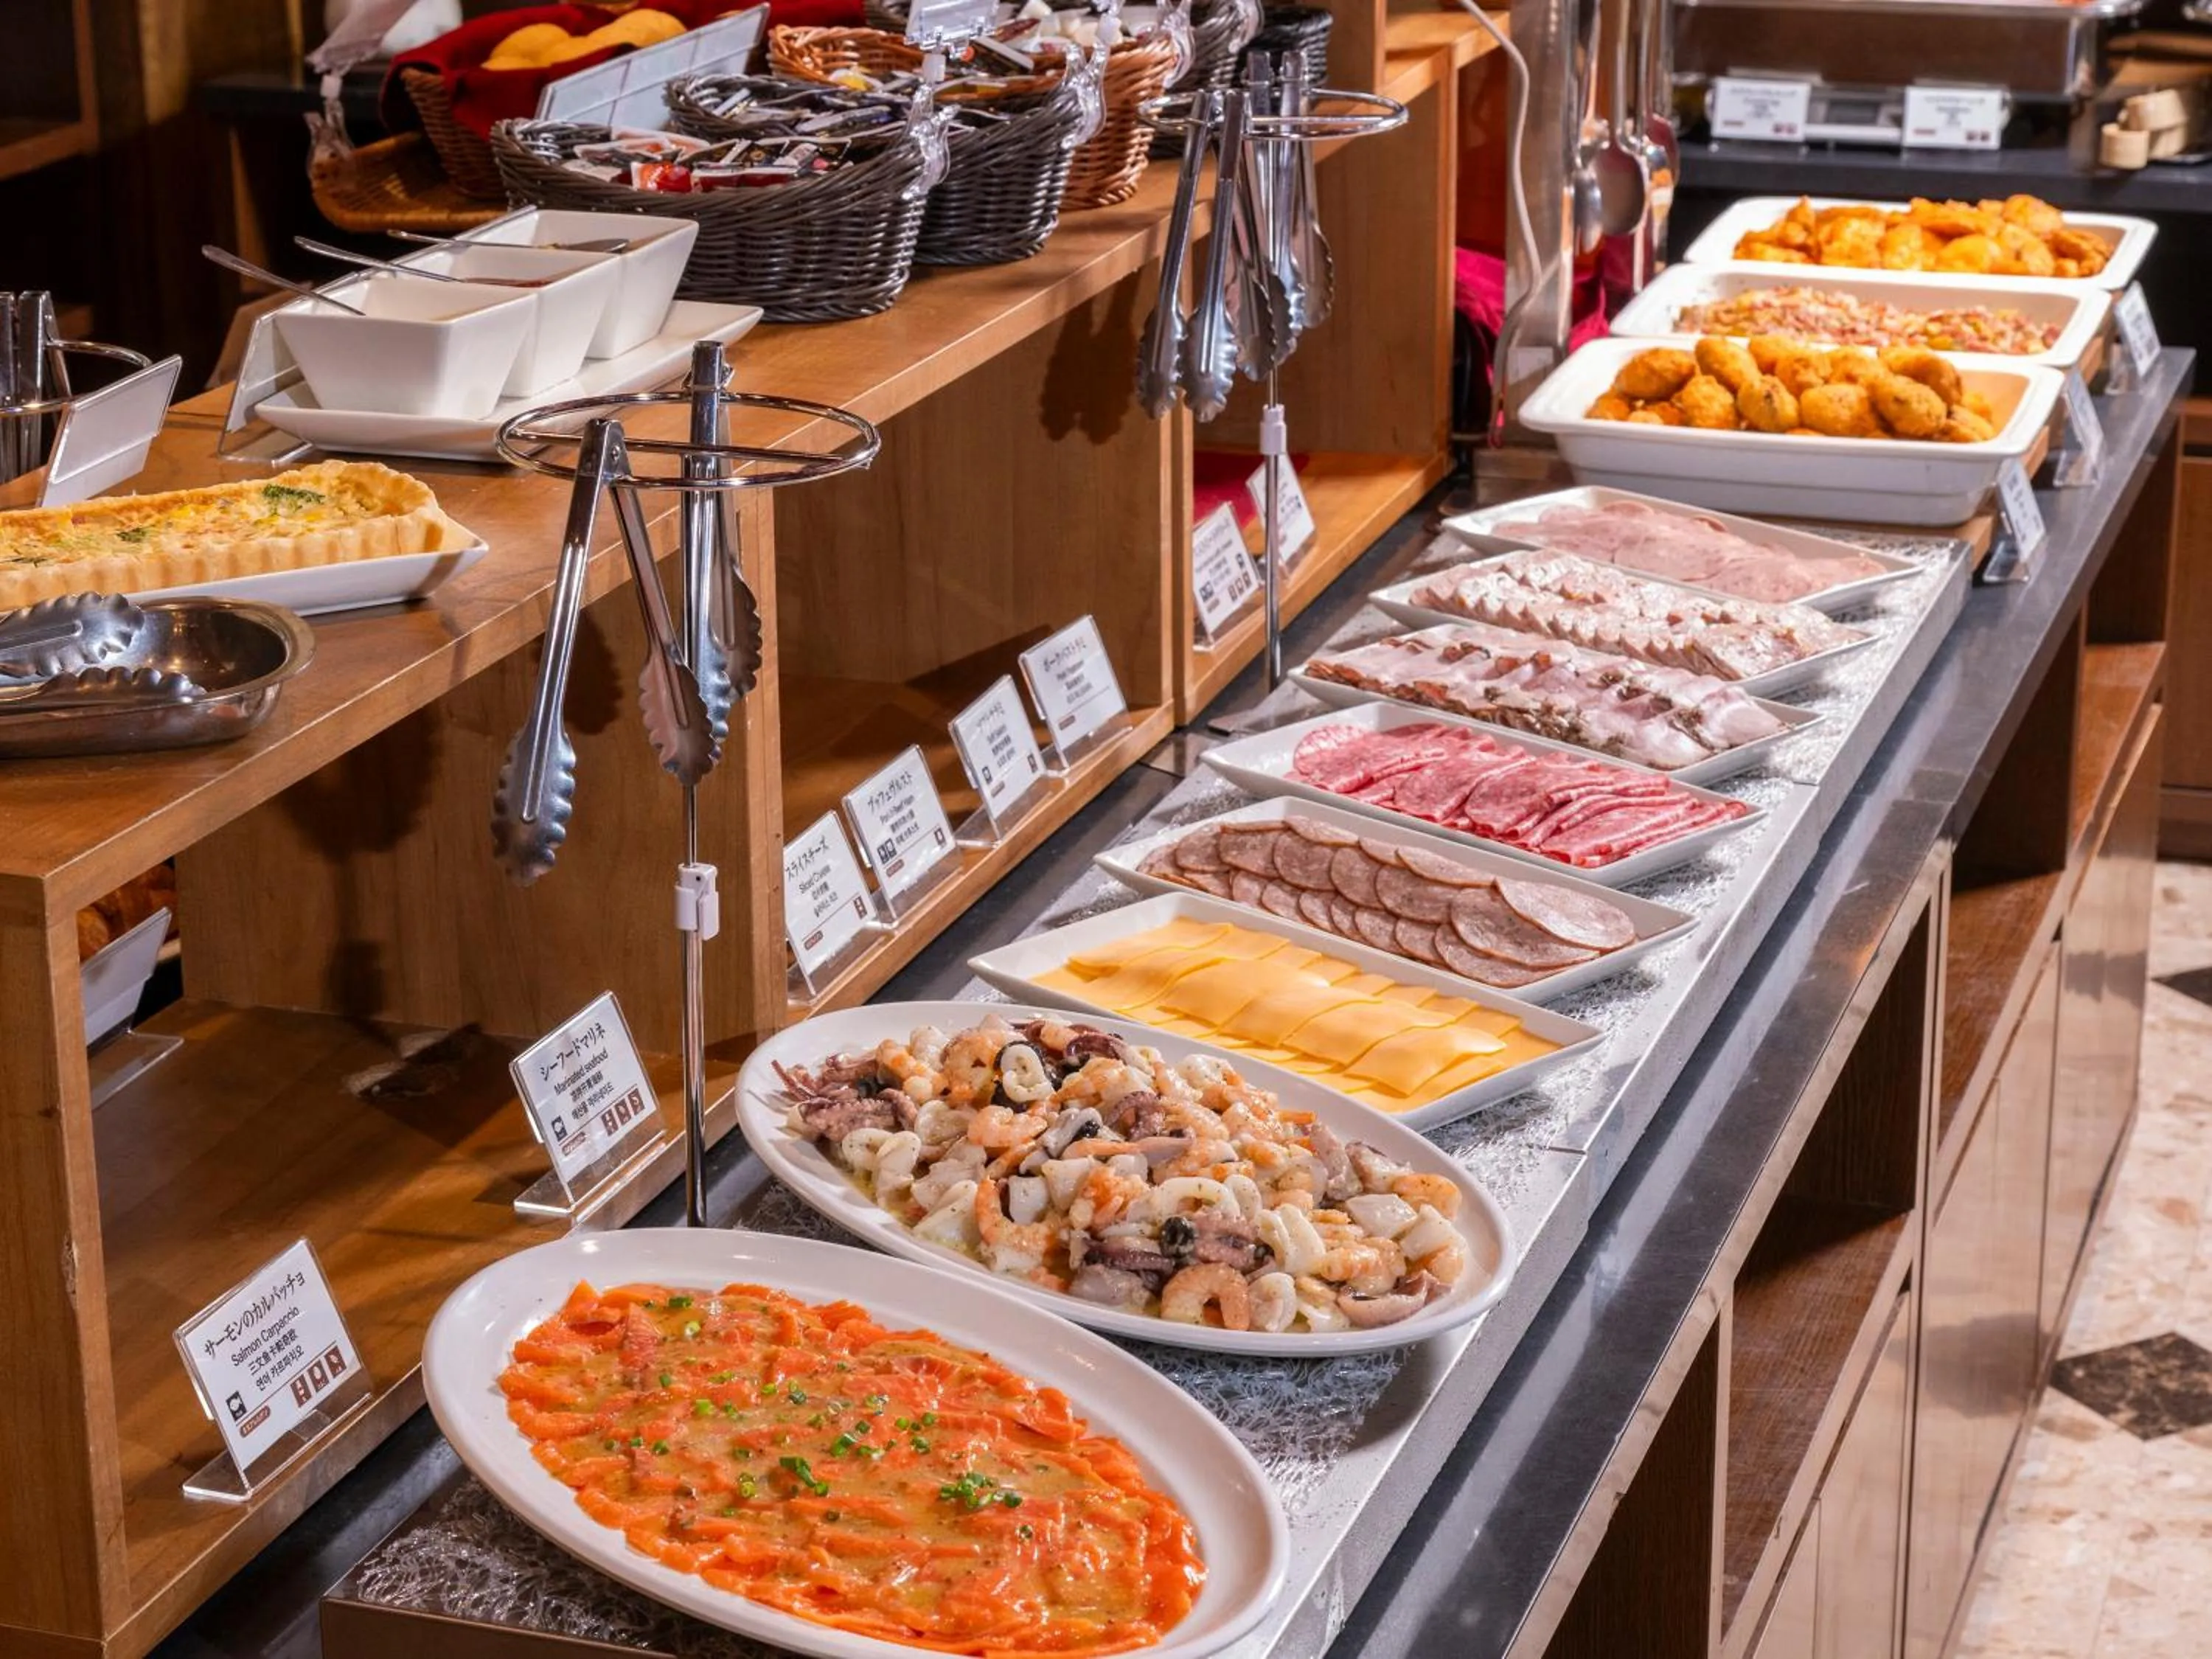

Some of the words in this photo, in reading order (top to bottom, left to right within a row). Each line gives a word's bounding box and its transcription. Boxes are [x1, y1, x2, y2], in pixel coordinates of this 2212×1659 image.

[539, 1022, 606, 1082] シーフードマリネ
[204, 1271, 305, 1359] サーモンのカルパッチョ
[231, 1337, 263, 1367] Salmon
[260, 1307, 300, 1343] Carpaccio
